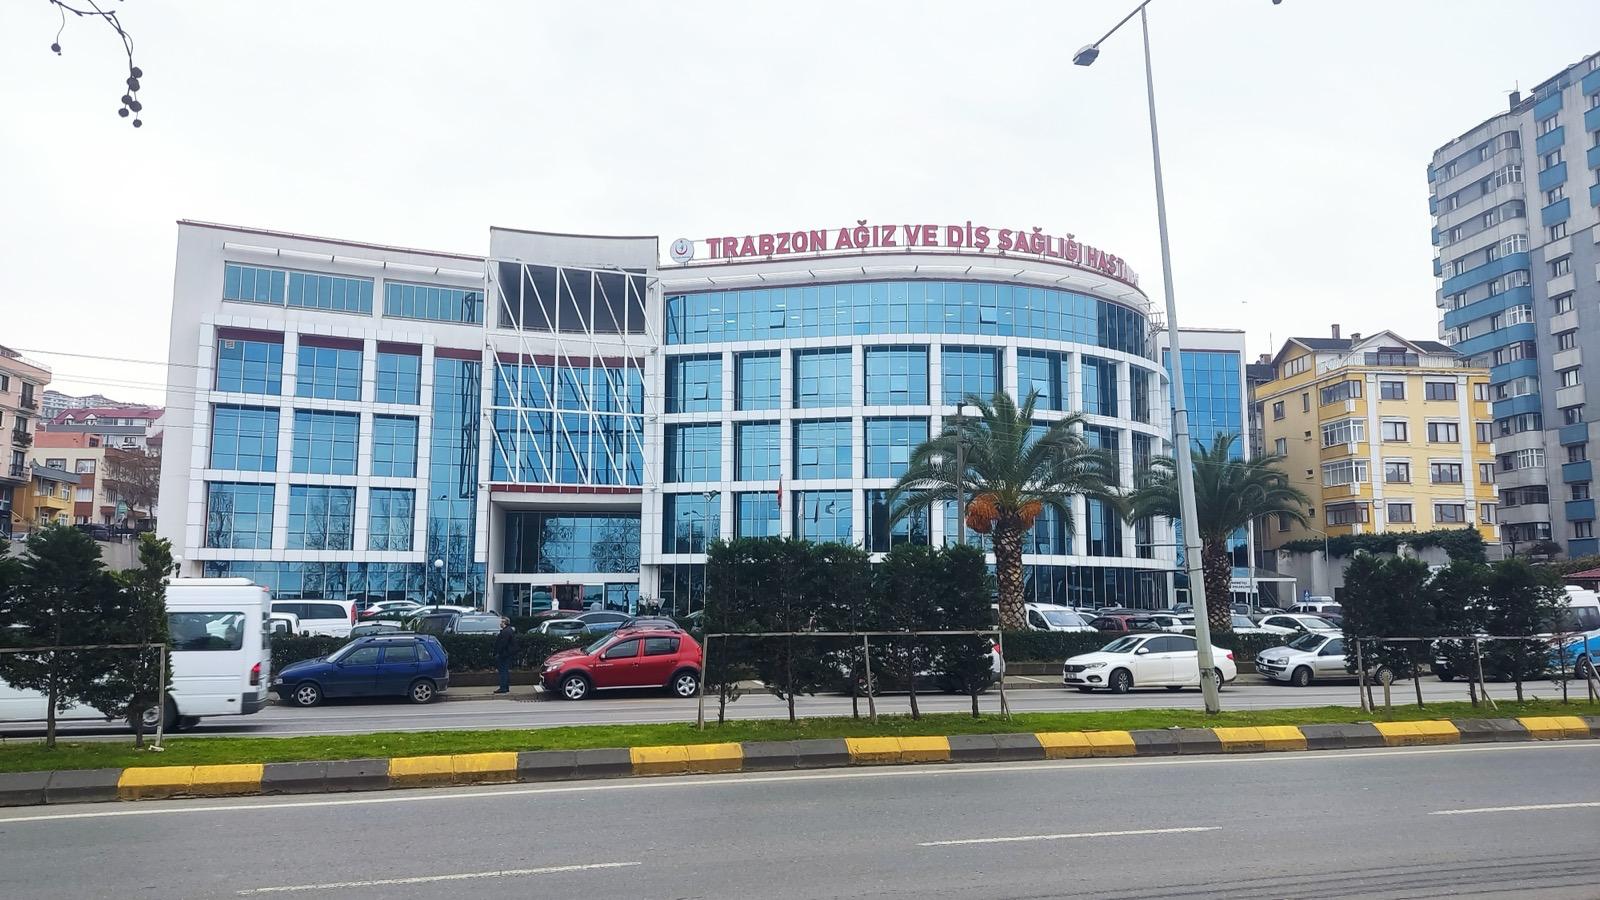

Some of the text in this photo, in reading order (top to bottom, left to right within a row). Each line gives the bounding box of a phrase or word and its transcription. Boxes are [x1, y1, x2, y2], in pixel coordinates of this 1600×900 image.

[706, 229, 827, 259] TRABZON
[835, 219, 897, 249] AĞIZ
[904, 224, 939, 246] VE
[947, 220, 991, 252] DİŞ
[998, 226, 1082, 263] SAĞLIĞI
